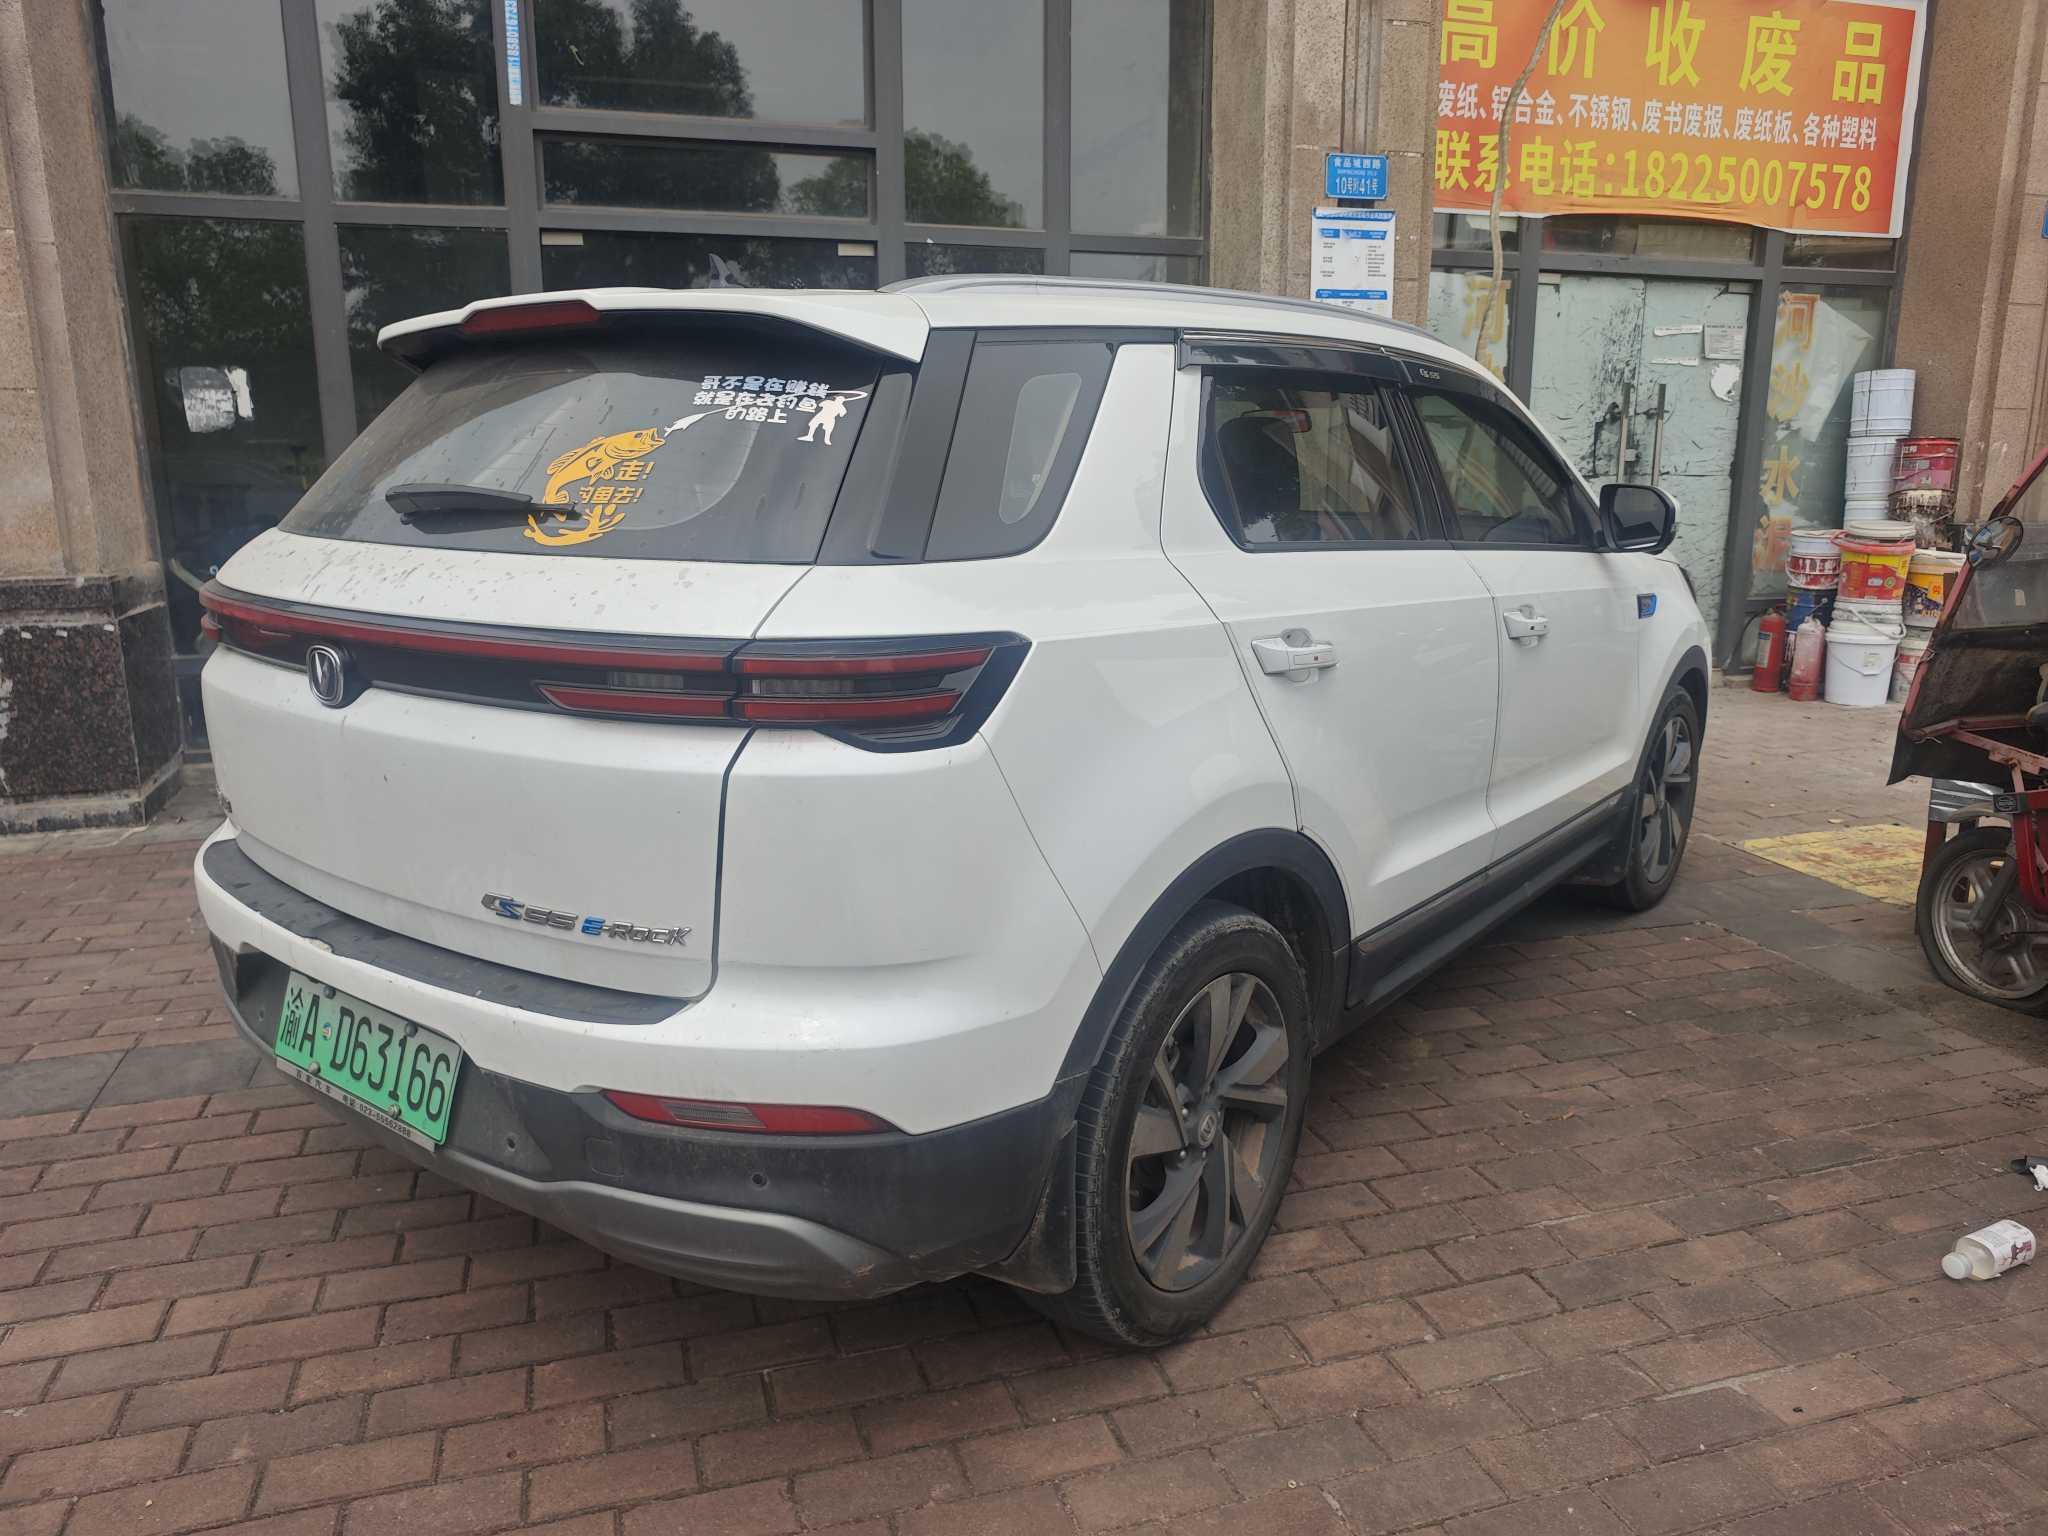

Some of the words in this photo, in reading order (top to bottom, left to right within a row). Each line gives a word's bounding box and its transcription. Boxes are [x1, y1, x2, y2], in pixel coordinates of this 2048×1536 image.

[1440, 0, 1888, 105] 高价收废品
[725, 405, 788, 424] 的路上
